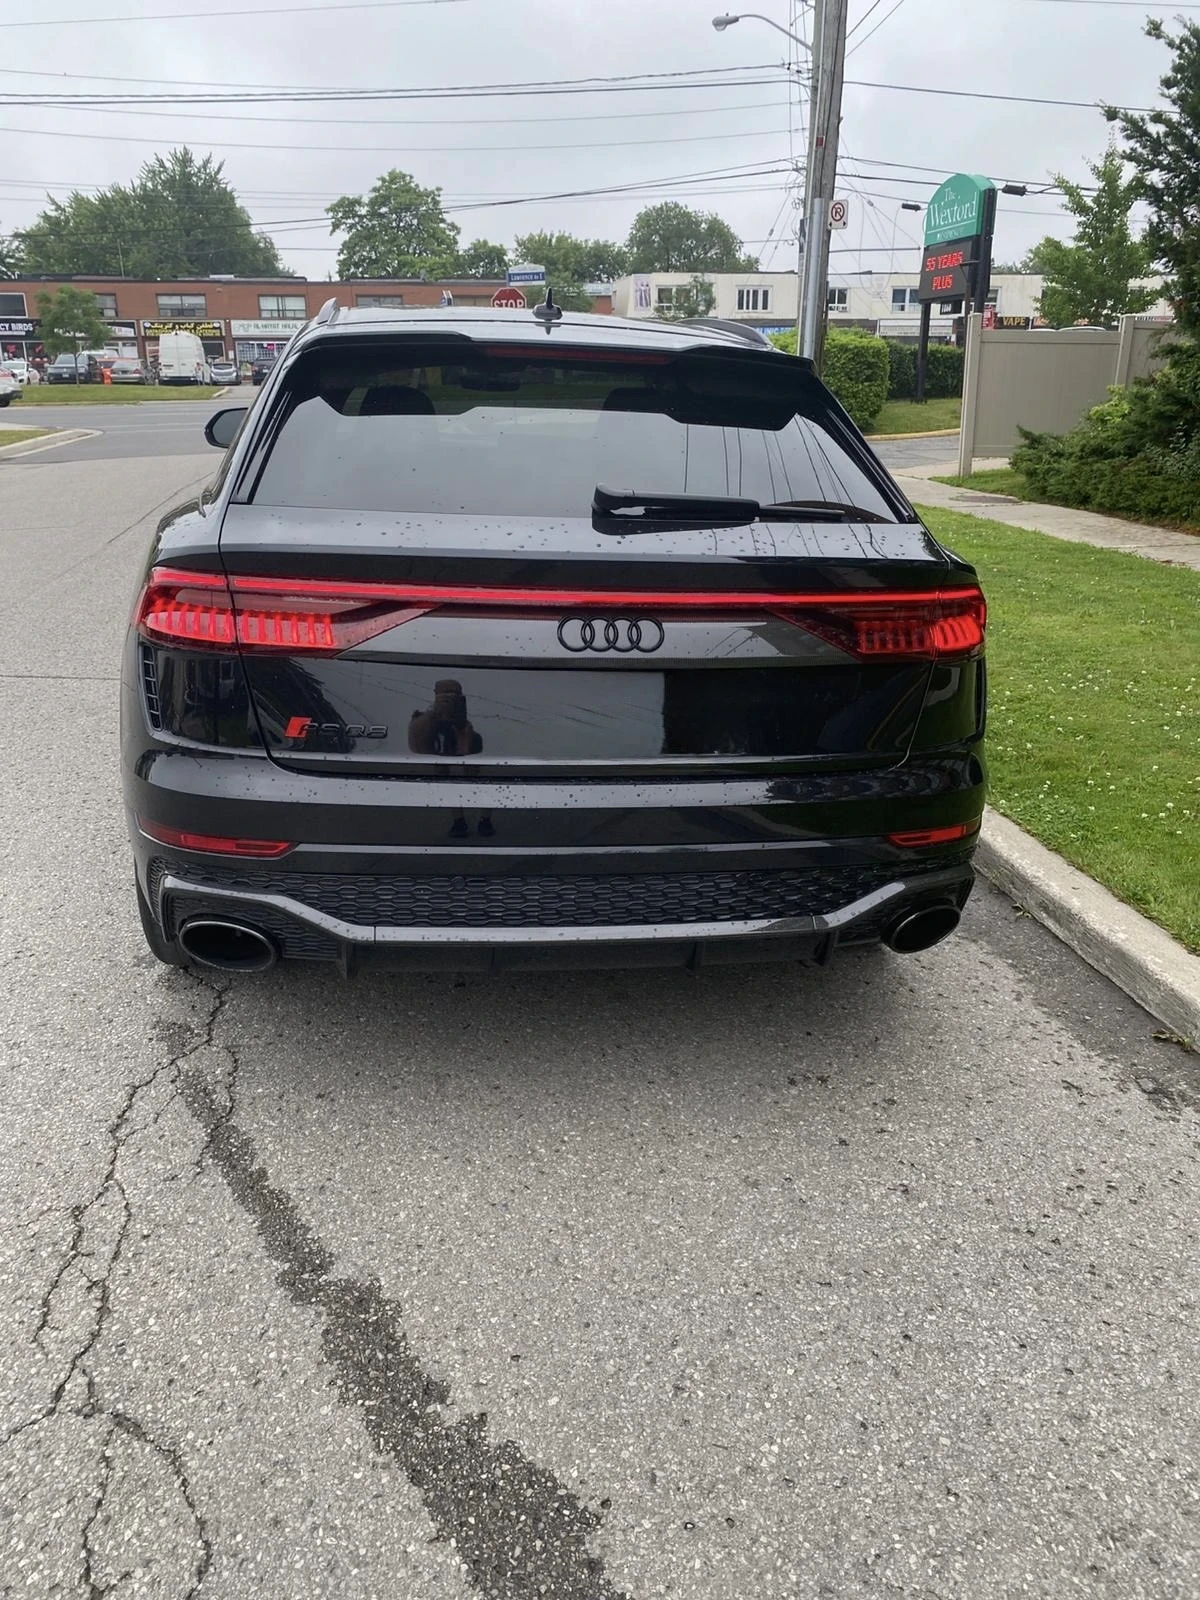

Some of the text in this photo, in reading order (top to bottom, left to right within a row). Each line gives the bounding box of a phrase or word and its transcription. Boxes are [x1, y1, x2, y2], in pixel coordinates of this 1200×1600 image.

[929, 191, 977, 227] Wexford
[938, 252, 963, 269] YEARS
[932, 275, 953, 290] PLUS
[493, 299, 524, 309] STOP
[1002, 316, 1026, 327] VAPE
